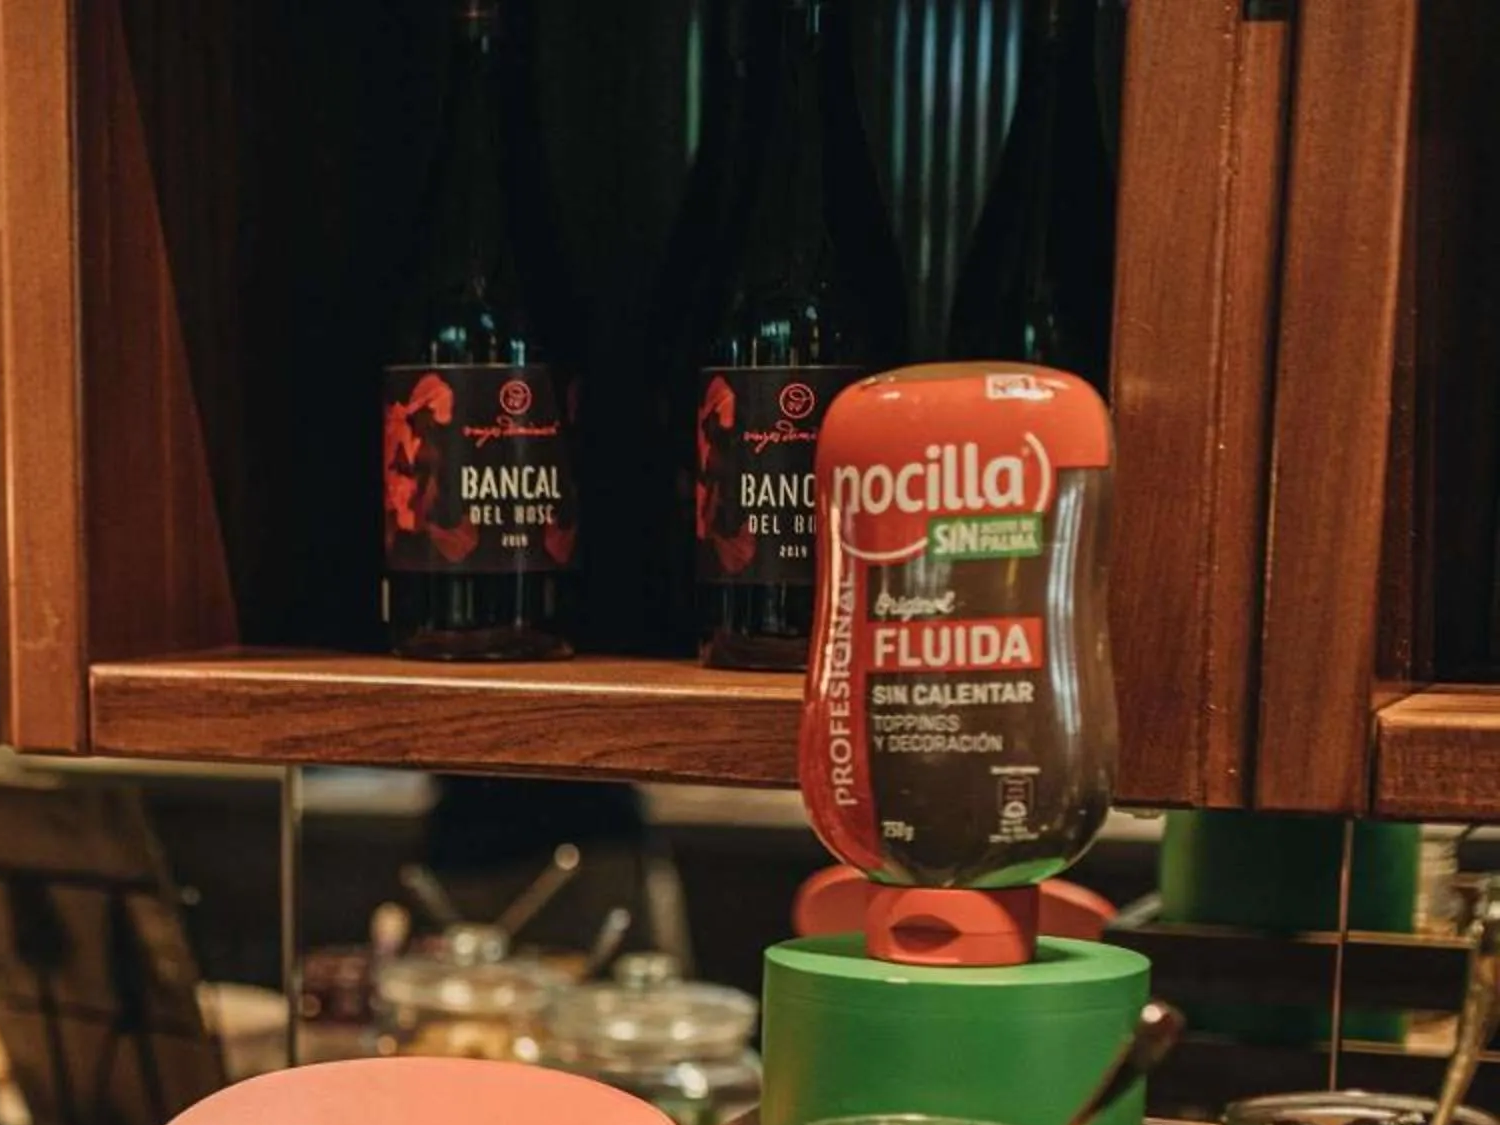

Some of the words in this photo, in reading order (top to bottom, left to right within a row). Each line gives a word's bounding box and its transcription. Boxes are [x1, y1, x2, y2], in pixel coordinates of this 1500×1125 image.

[461, 465, 562, 499] BANCAL
[740, 472, 816, 508] BANC
[835, 442, 1024, 516] nocilla
[469, 504, 504, 524] DEL
[748, 514, 781, 534] DEL
[933, 522, 978, 554] SIN
[874, 624, 1032, 667] FLUIDA
[829, 568, 857, 806] PROFESIONAL
[873, 685, 908, 705] SIN
[912, 681, 1034, 707] CALENTAR
[873, 714, 961, 732] TOPPINGS
[873, 736, 885, 751] Y
[888, 732, 1004, 752] DECORACIÓN
